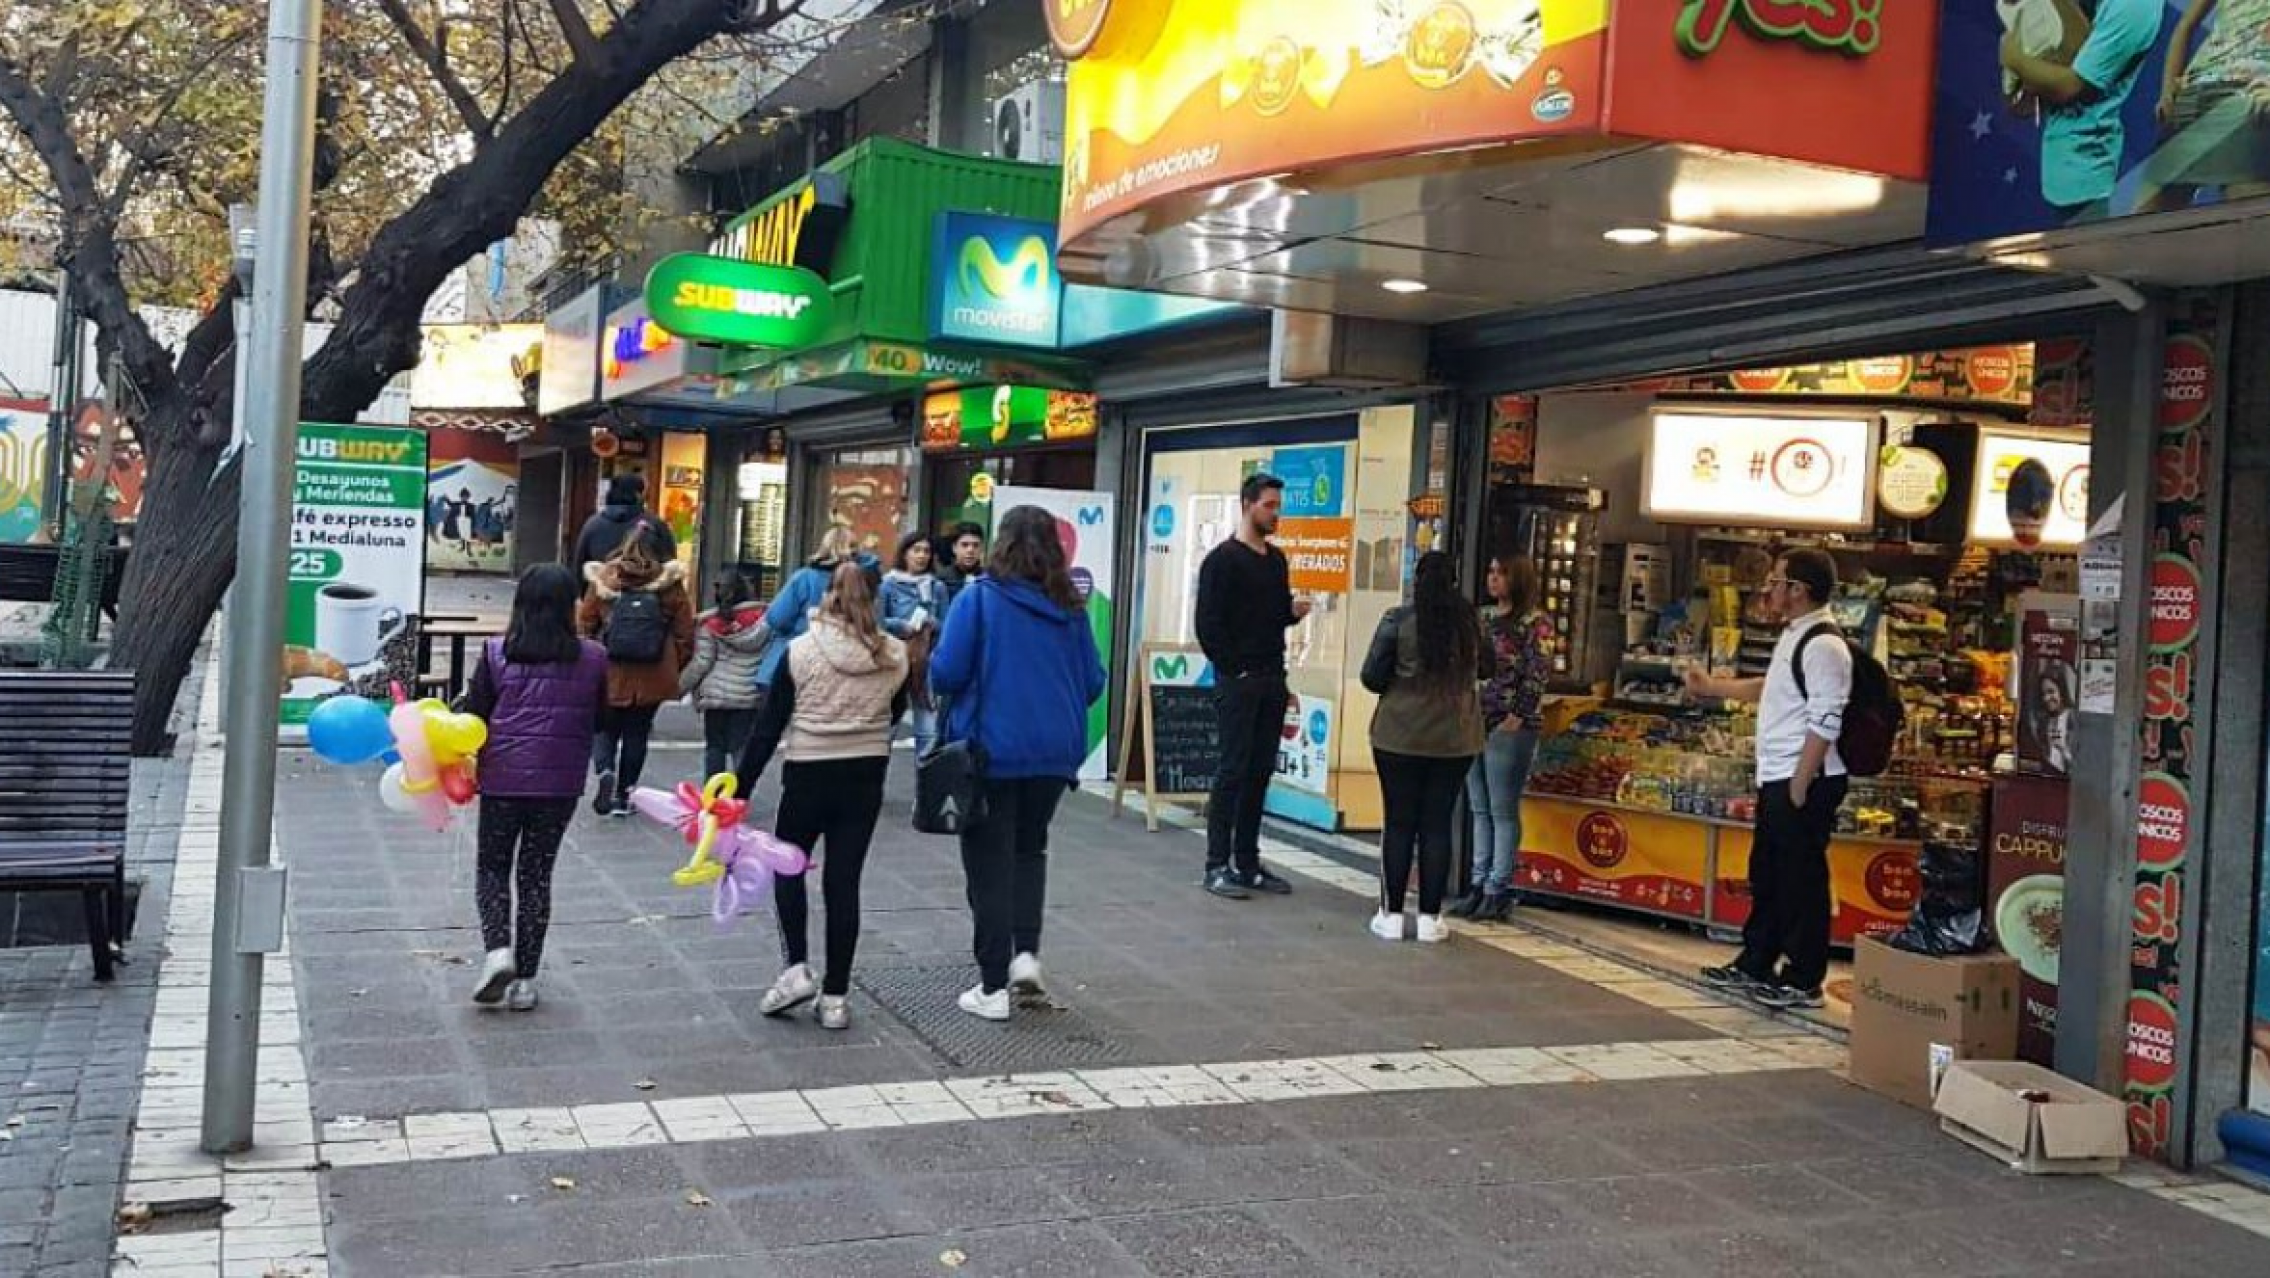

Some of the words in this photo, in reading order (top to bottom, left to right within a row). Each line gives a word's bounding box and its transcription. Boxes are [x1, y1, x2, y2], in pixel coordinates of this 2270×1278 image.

[1136, 141, 1221, 187] emociones
[674, 282, 811, 319] SUBWAY
[954, 304, 1048, 334] movistar
[923, 352, 982, 376] Wow!
[2163, 367, 2206, 382] OSCOS
[2163, 385, 2204, 399] NICOS
[294, 434, 411, 461] UBWAY
[296, 469, 391, 489] Desayunos
[306, 484, 396, 503] Meriendas
[290, 508, 316, 524] fé
[322, 511, 417, 529] expresso
[293, 529, 303, 543] 1
[309, 529, 407, 547] Medialuna
[290, 552, 327, 574] 25
[2152, 586, 2194, 601] OSCOS
[2152, 605, 2192, 620] NICOS
[2138, 803, 2184, 823] OSCOS
[2022, 820, 2065, 839] DISFRU
[2137, 822, 2182, 843] NICOS
[1996, 833, 2067, 863] CAPPU
[2129, 1022, 2174, 1046] OSCOS
[2127, 1040, 2172, 1064] NICOS
